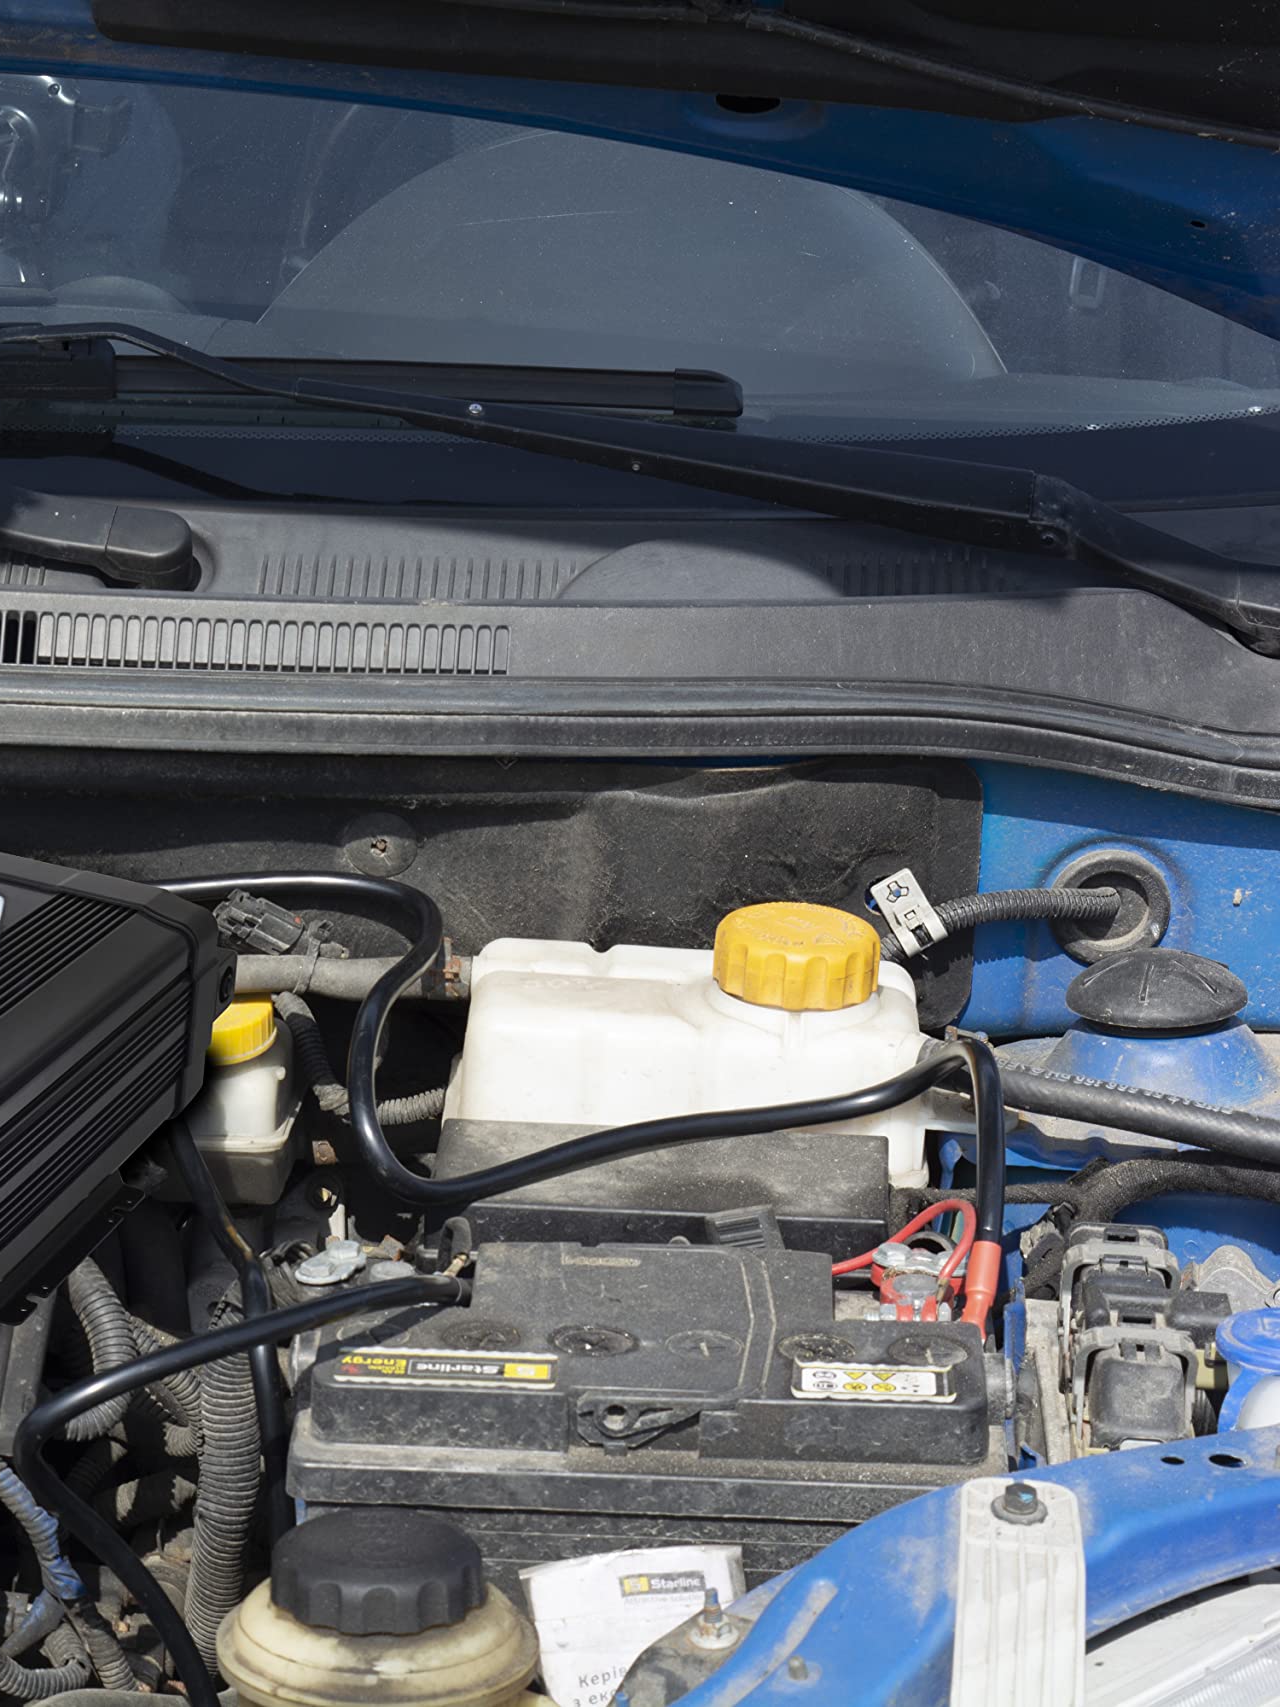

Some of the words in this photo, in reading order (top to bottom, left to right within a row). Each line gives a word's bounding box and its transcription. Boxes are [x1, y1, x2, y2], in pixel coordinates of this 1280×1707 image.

[342, 1355, 407, 1367] Energy
[416, 1363, 500, 1374] Starline
[650, 1577, 701, 1589] Starline
